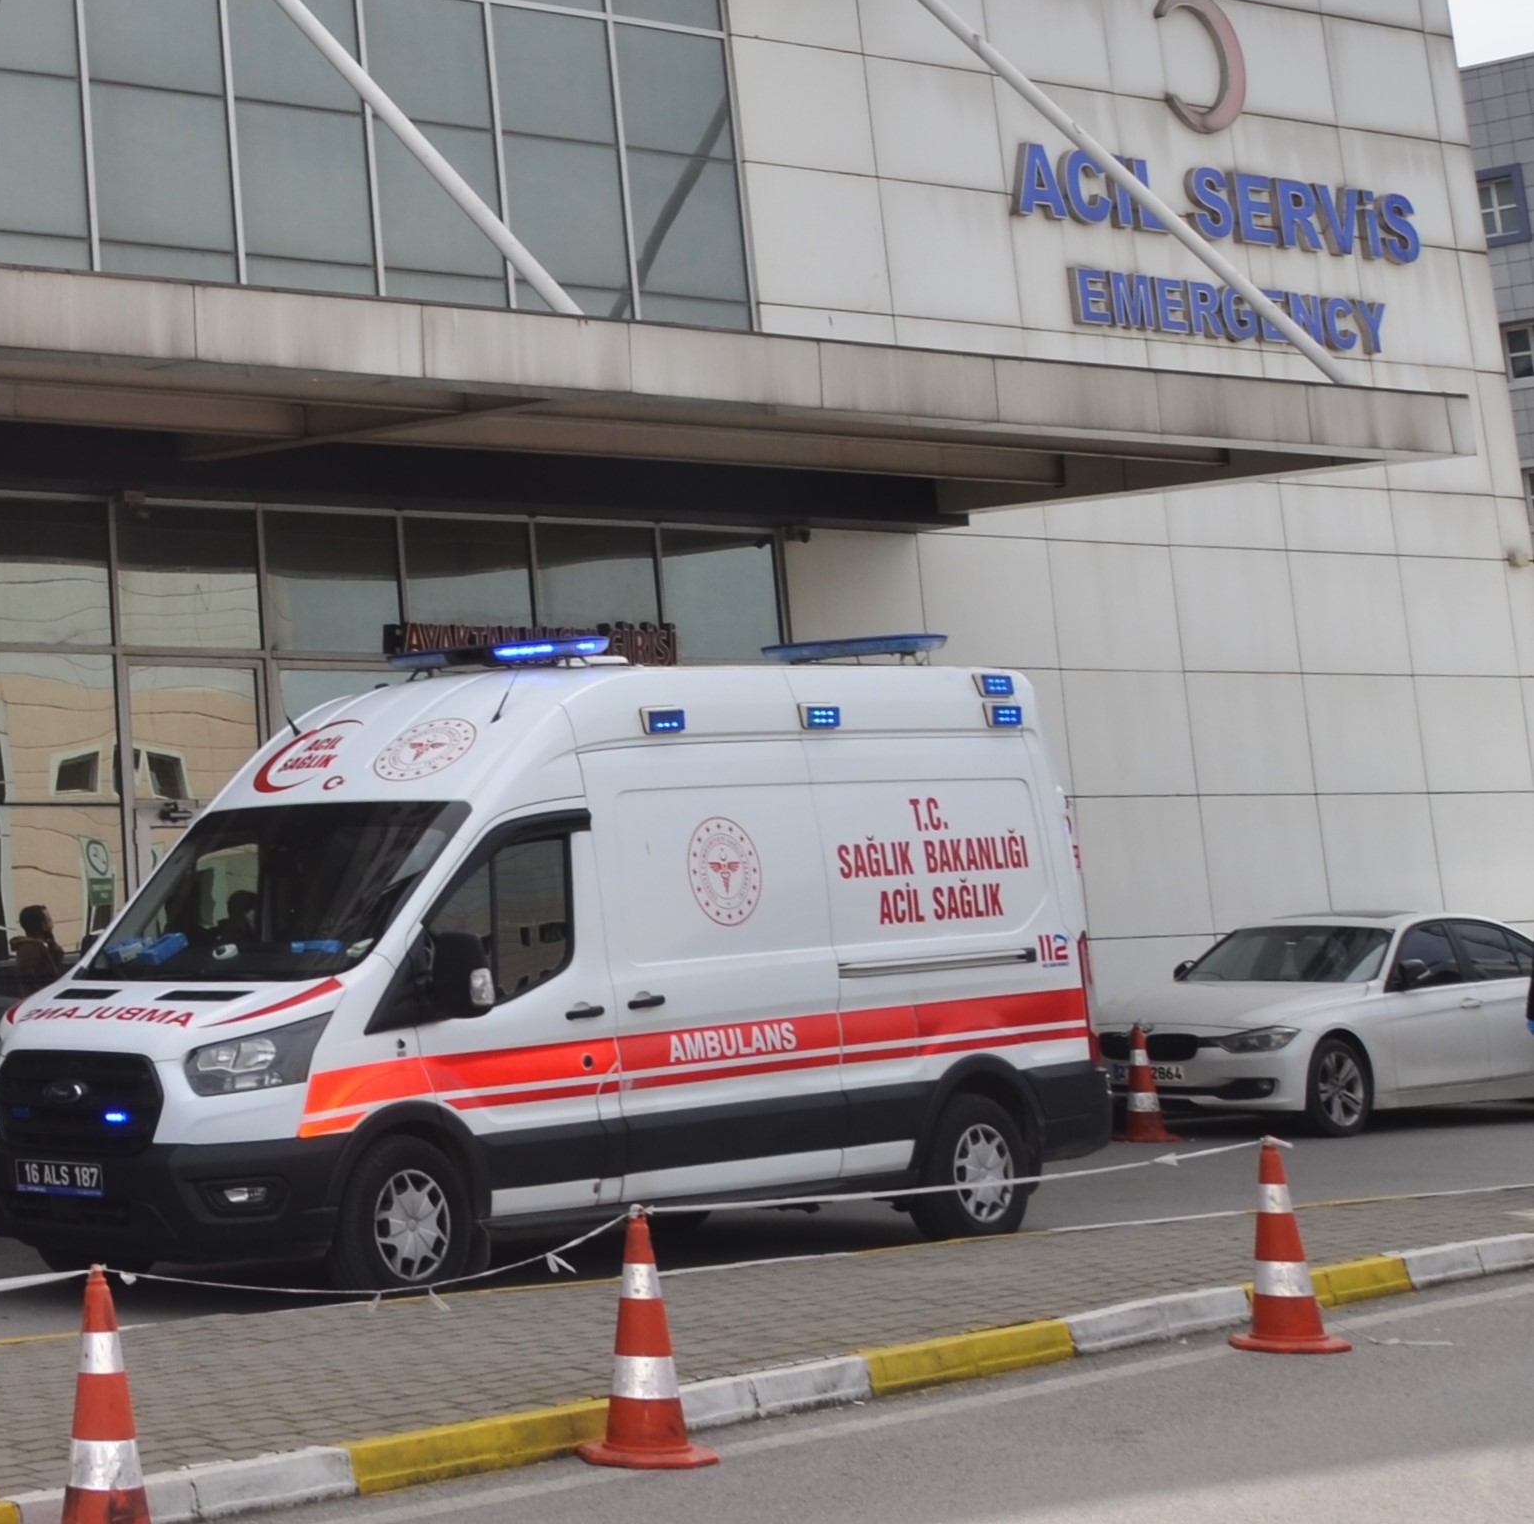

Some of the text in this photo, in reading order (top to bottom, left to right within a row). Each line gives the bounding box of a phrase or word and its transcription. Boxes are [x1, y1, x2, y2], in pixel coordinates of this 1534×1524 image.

[1069, 266, 1387, 355] EMERGENCY
[909, 797, 949, 831] T.C.
[837, 835, 915, 880] SAĞLIK
[923, 828, 1029, 874] BAKANLIĞI
[880, 877, 1004, 925] ACİL SAĞLIK
[1037, 933, 1068, 961] 112
[670, 1022, 797, 1063] AMBULANS
[25, 1163, 98, 1187] 16 ALS 187
